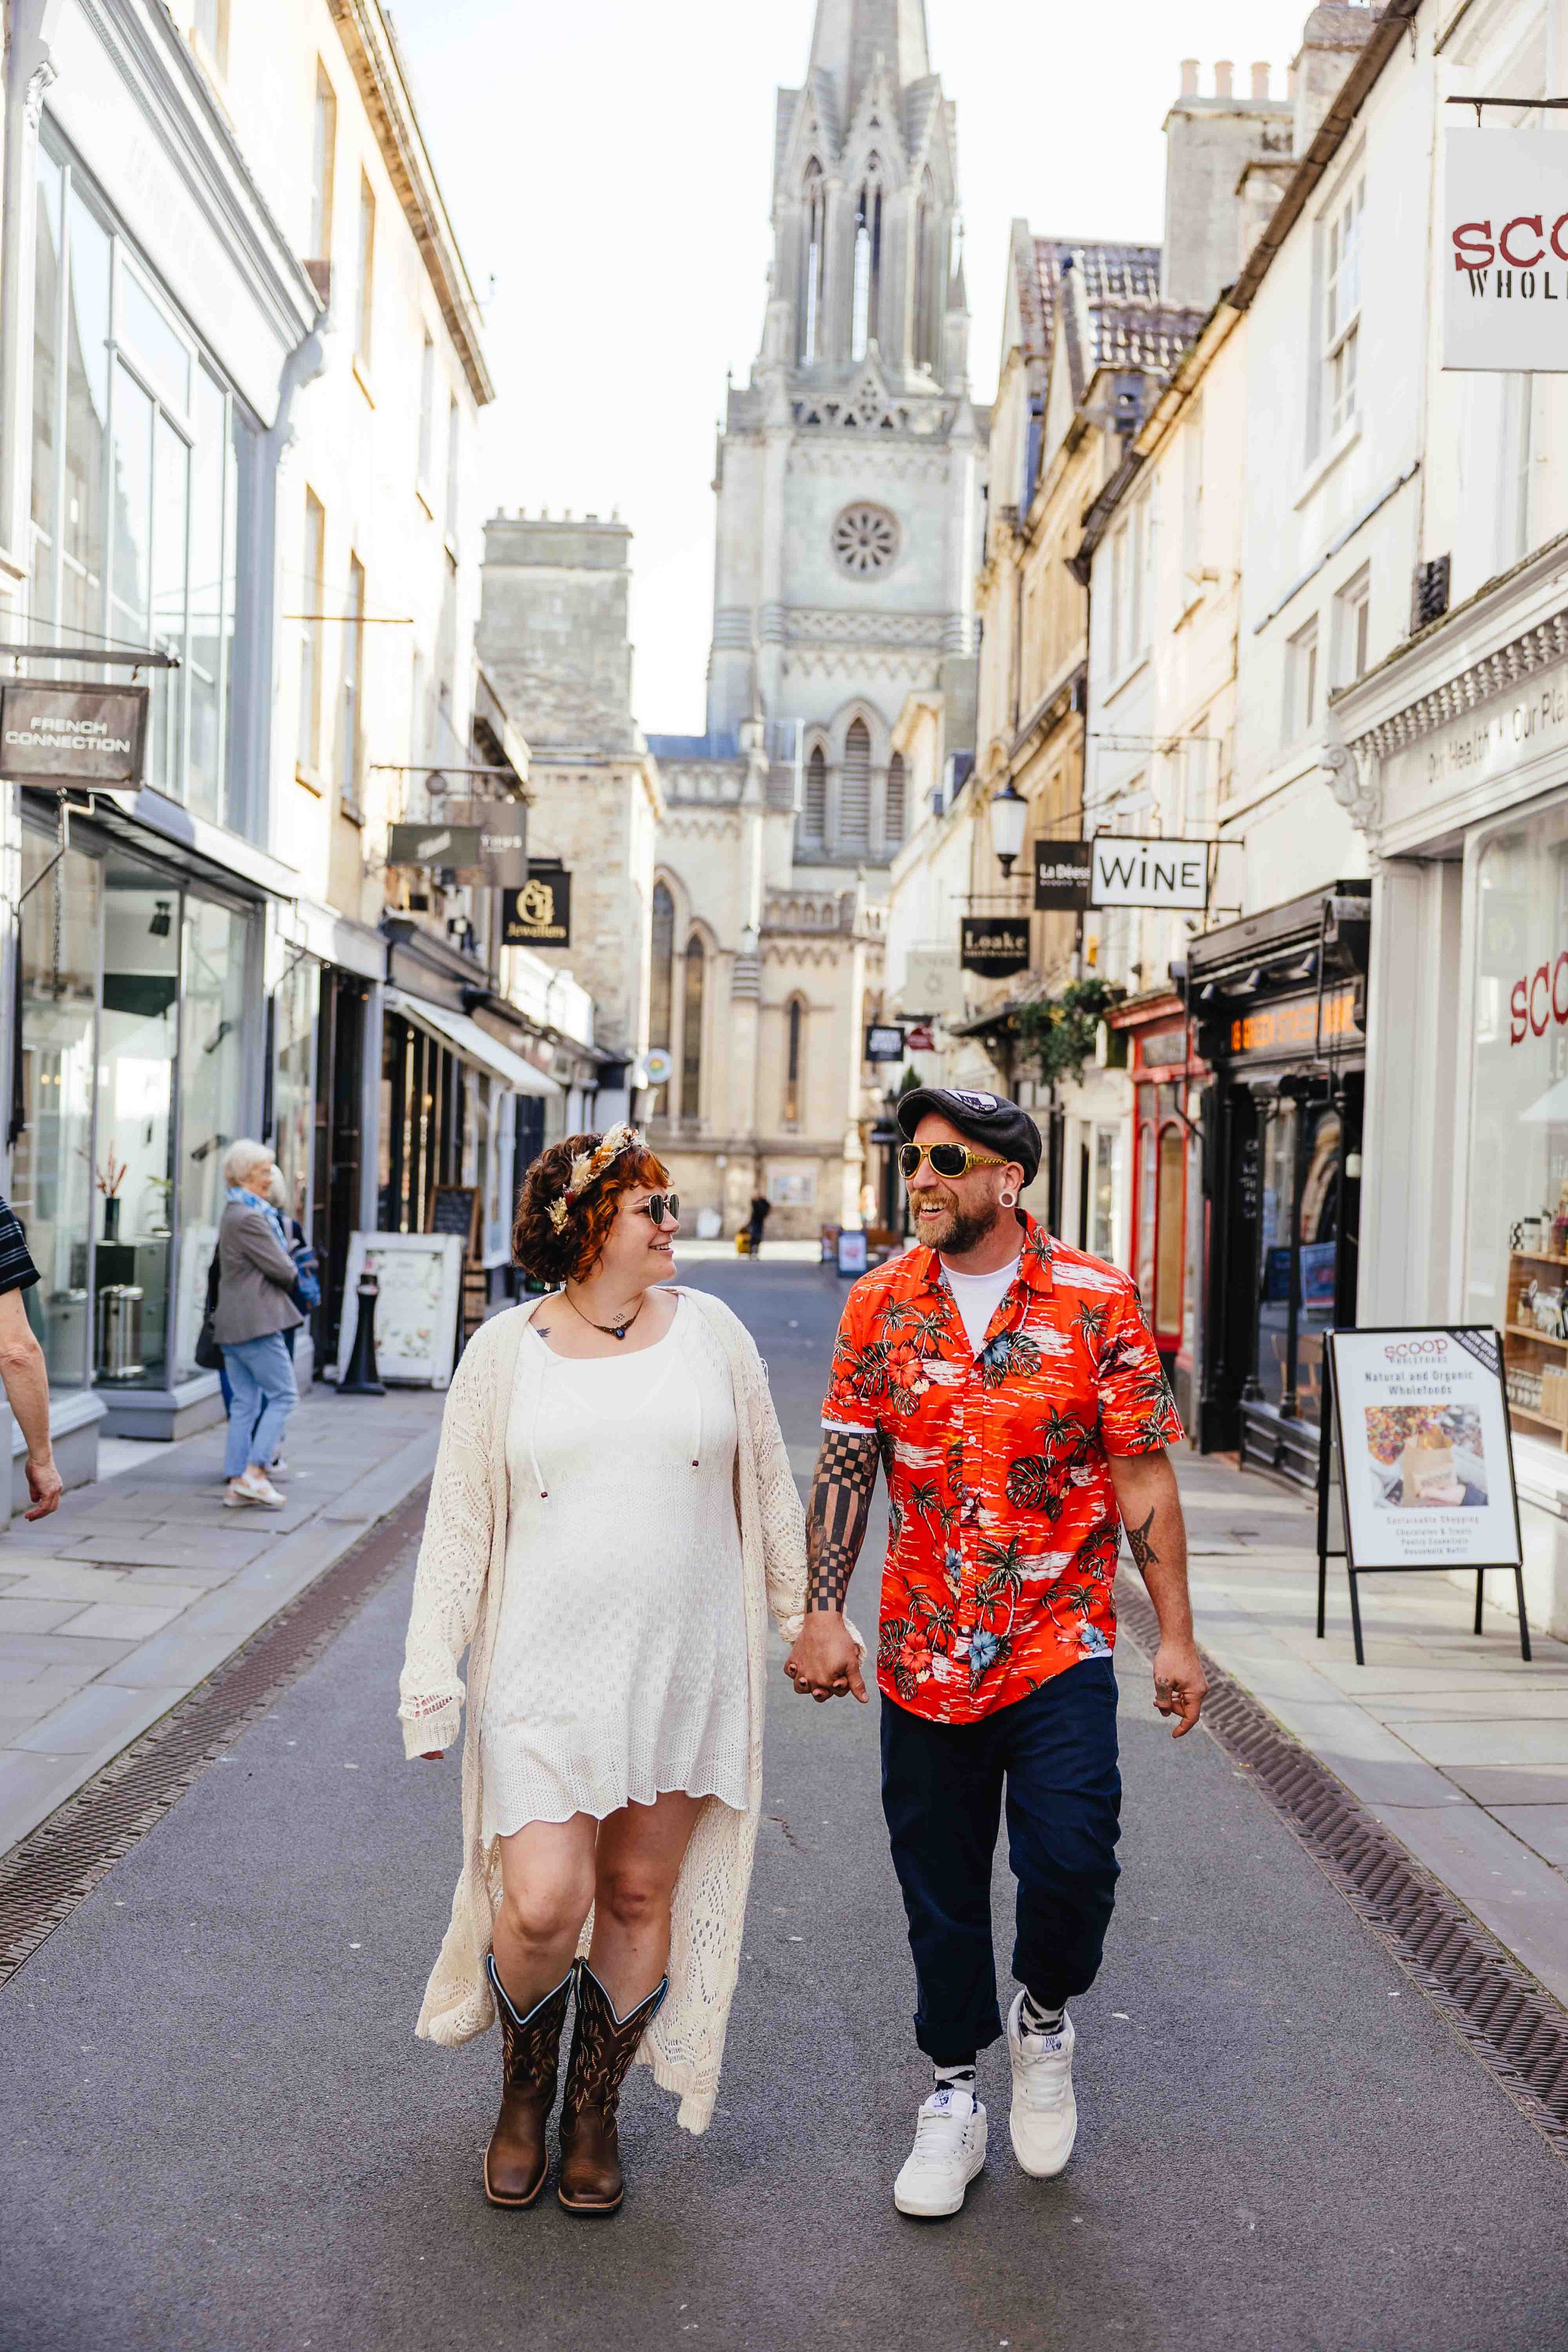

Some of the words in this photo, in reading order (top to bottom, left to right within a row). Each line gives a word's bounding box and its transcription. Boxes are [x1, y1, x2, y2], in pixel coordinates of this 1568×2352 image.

[1468, 269, 1568, 300] WHOL
[31, 717, 108, 735] FRENCH
[1513, 707, 1537, 743] Our
[5, 731, 130, 753] CONNECTION
[965, 930, 1025, 950] Loake
[1365, 1371, 1406, 1381] Natural
[1410, 1371, 1429, 1380] and
[1433, 1370, 1473, 1382] Organic
[1389, 1385, 1453, 1396] Wholefoods
